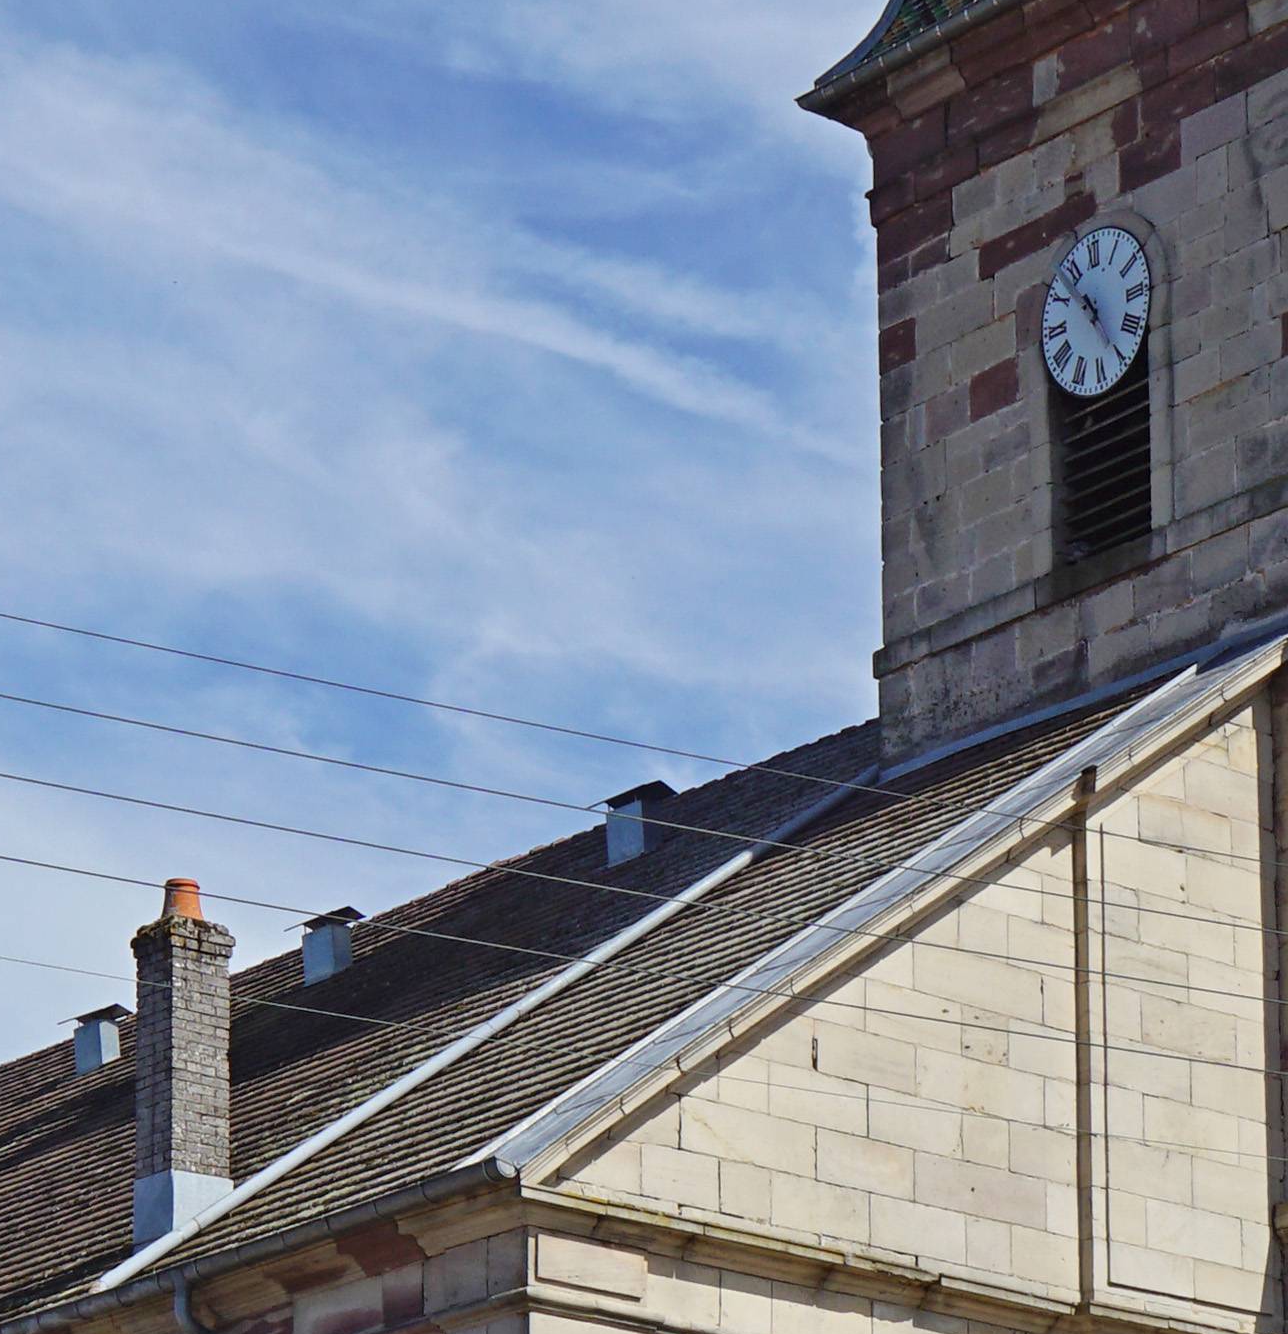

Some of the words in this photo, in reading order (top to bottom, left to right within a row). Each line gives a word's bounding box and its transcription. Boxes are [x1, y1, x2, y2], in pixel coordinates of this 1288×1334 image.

[1087, 239, 1100, 270] XII
[1108, 239, 1119, 265] I
[1119, 251, 1138, 279] II
[1066, 259, 1083, 287] XI
[1052, 292, 1070, 307] X
[1125, 281, 1144, 303] III
[1048, 319, 1067, 340] IX
[1120, 312, 1141, 336] IIII
[1053, 339, 1074, 373] VIII
[1113, 343, 1127, 366] V
[1072, 355, 1087, 386] VII
